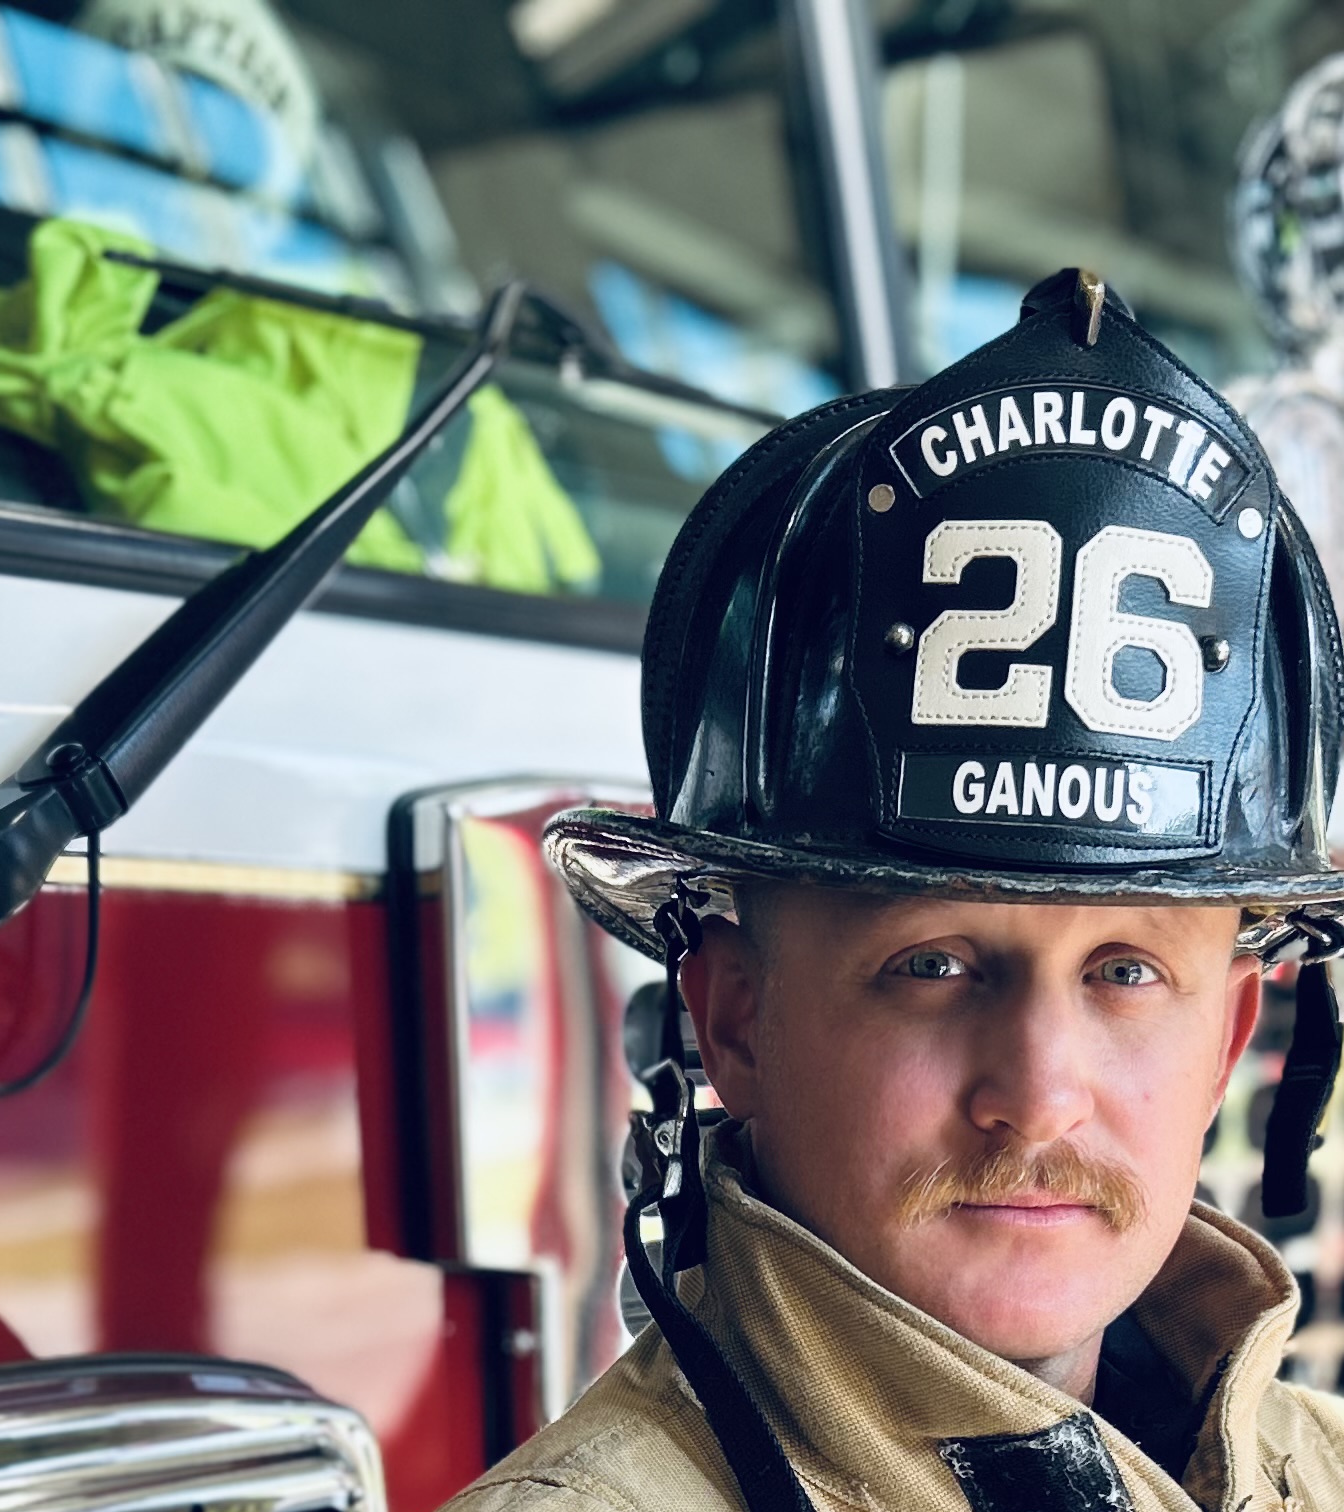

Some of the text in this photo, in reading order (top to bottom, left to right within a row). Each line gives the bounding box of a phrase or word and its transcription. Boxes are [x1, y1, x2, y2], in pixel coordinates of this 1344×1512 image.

[919, 390, 1232, 502] CHARLOTTE
[911, 519, 1214, 742] 26
[952, 760, 1154, 826] GANOUS
